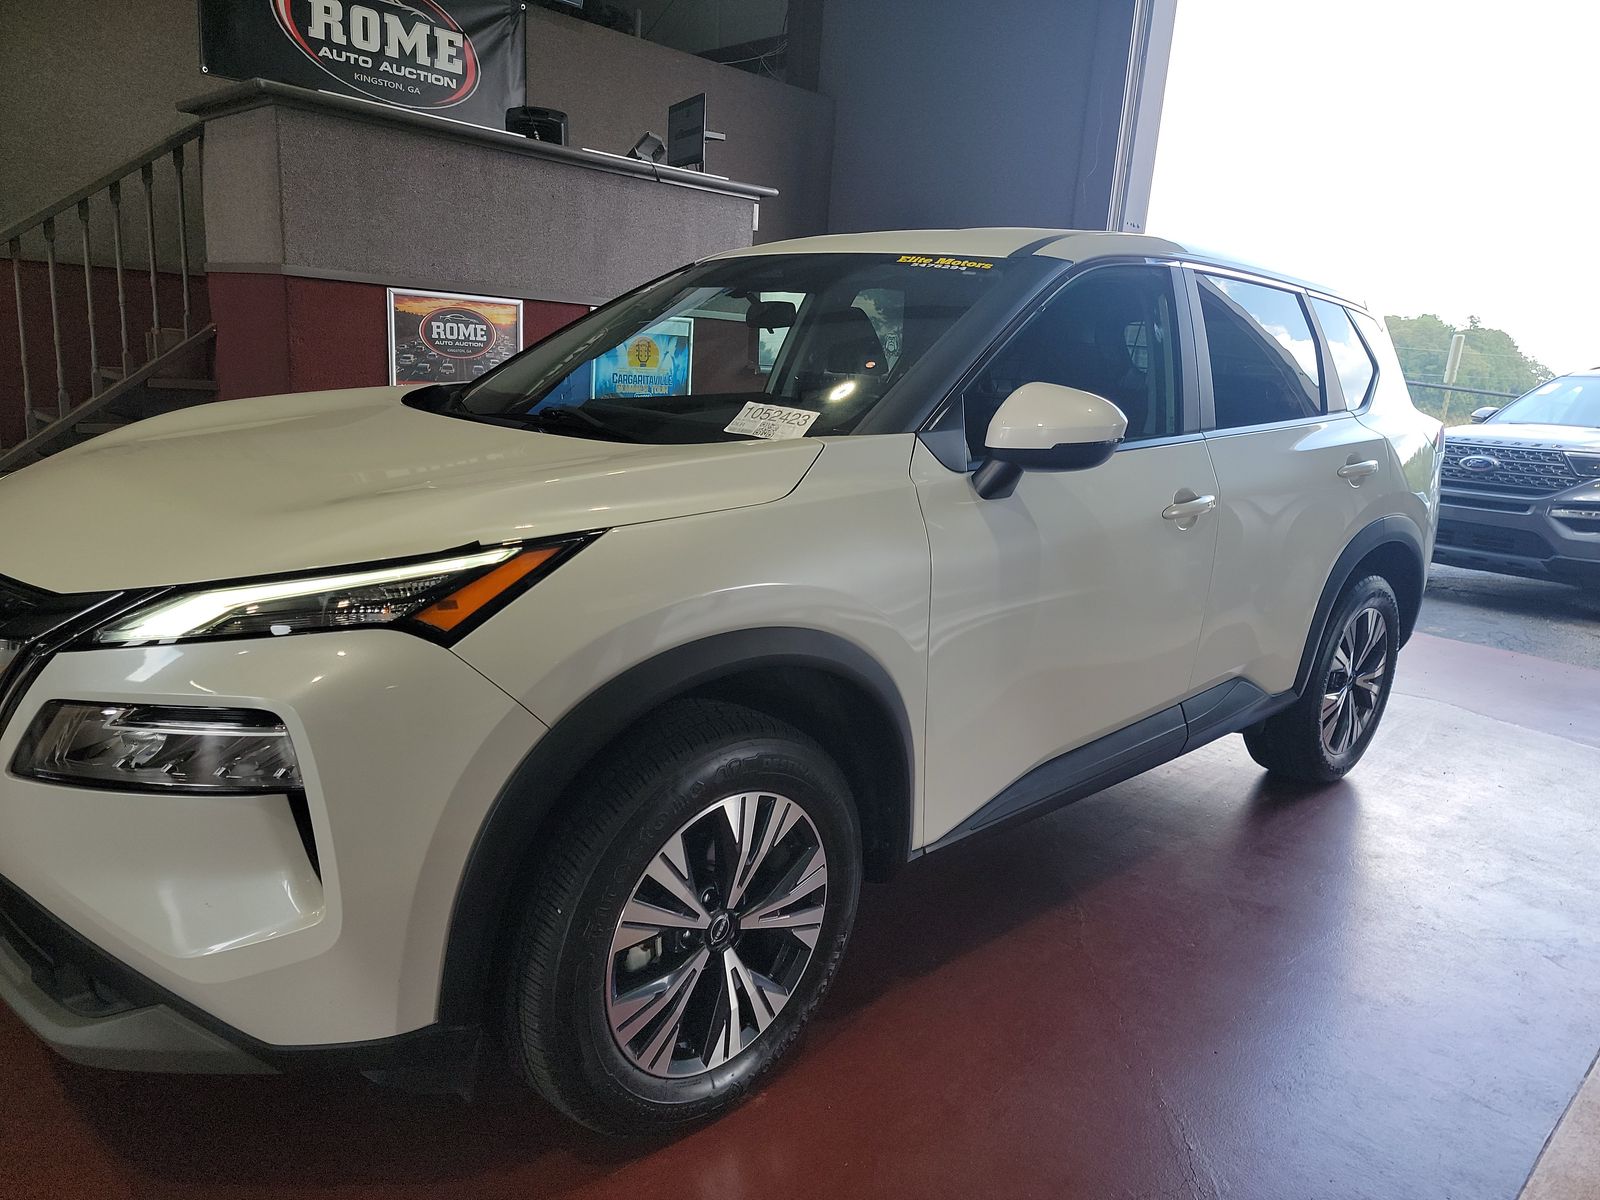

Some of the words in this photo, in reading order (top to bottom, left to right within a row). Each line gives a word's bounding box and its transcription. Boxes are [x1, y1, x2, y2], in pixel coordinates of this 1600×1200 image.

[308, 0, 463, 75] ROME
[317, 46, 373, 68] AUTO
[379, 61, 457, 89] AUCTION
[354, 72, 405, 91] KINGSTON,
[407, 85, 421, 95] GA
[896, 255, 933, 263] Elite
[934, 257, 993, 269] Motors
[431, 321, 487, 341] ROME
[612, 372, 673, 386] CARGARITAVILLE
[743, 406, 811, 427] 1052423
